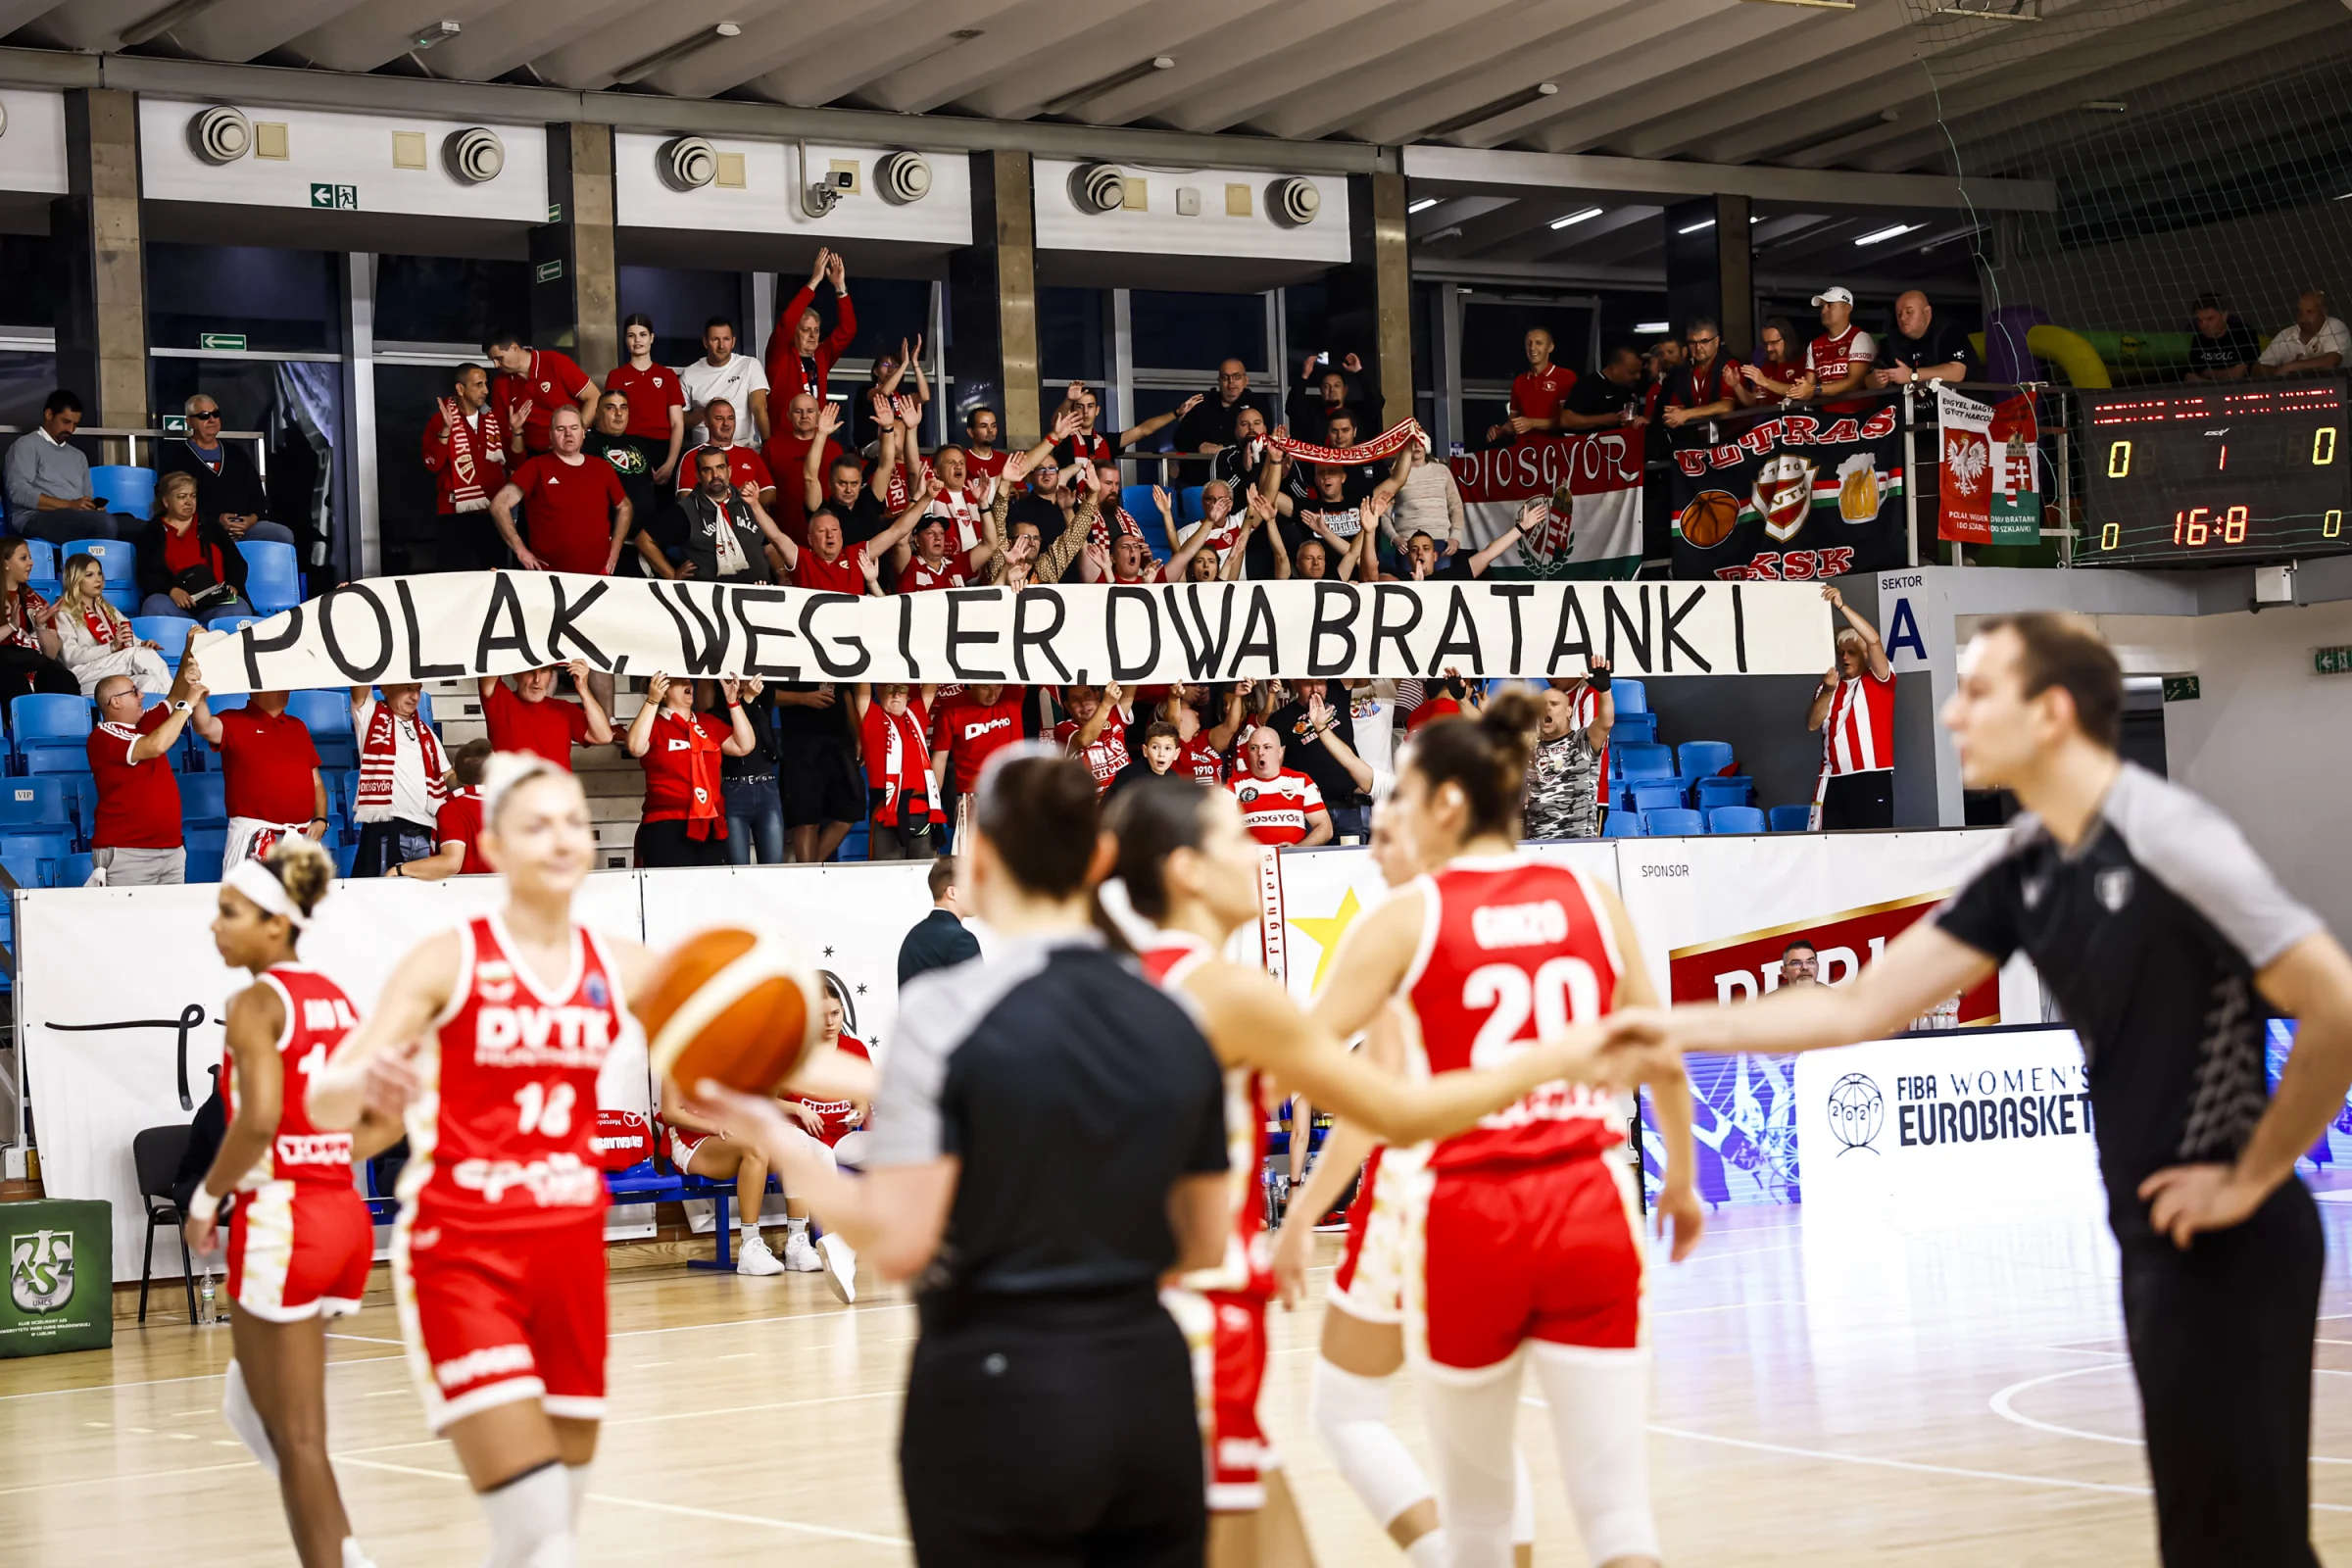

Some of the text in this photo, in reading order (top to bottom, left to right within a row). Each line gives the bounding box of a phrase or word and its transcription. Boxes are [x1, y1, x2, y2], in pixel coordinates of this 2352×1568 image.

[1674, 406, 1896, 476] ULTRAS
[2108, 441, 2132, 478] 0
[2219, 444, 2227, 471] 1
[2312, 426, 2336, 466] 0
[2100, 522, 2120, 551] 0
[2173, 506, 2249, 546] 16:8
[2323, 510, 2342, 538] 0
[1882, 575, 1923, 590] SEKTOR
[242, 571, 629, 689] POLAK,
[1106, 583, 1279, 681] DWA
[1307, 581, 1747, 675] BRATANKI
[1886, 598, 1928, 662] A
[1194, 765, 1214, 775] 1910
[1642, 864, 1690, 877] SPONSOR
[475, 1006, 611, 1049] DVTK
[1463, 956, 1599, 1070] 20
[1897, 1065, 2089, 1101] FIBA WOMEN'S
[1899, 1093, 2091, 1147] EUROBASKET
[32, 1298, 53, 1307] UMCS
